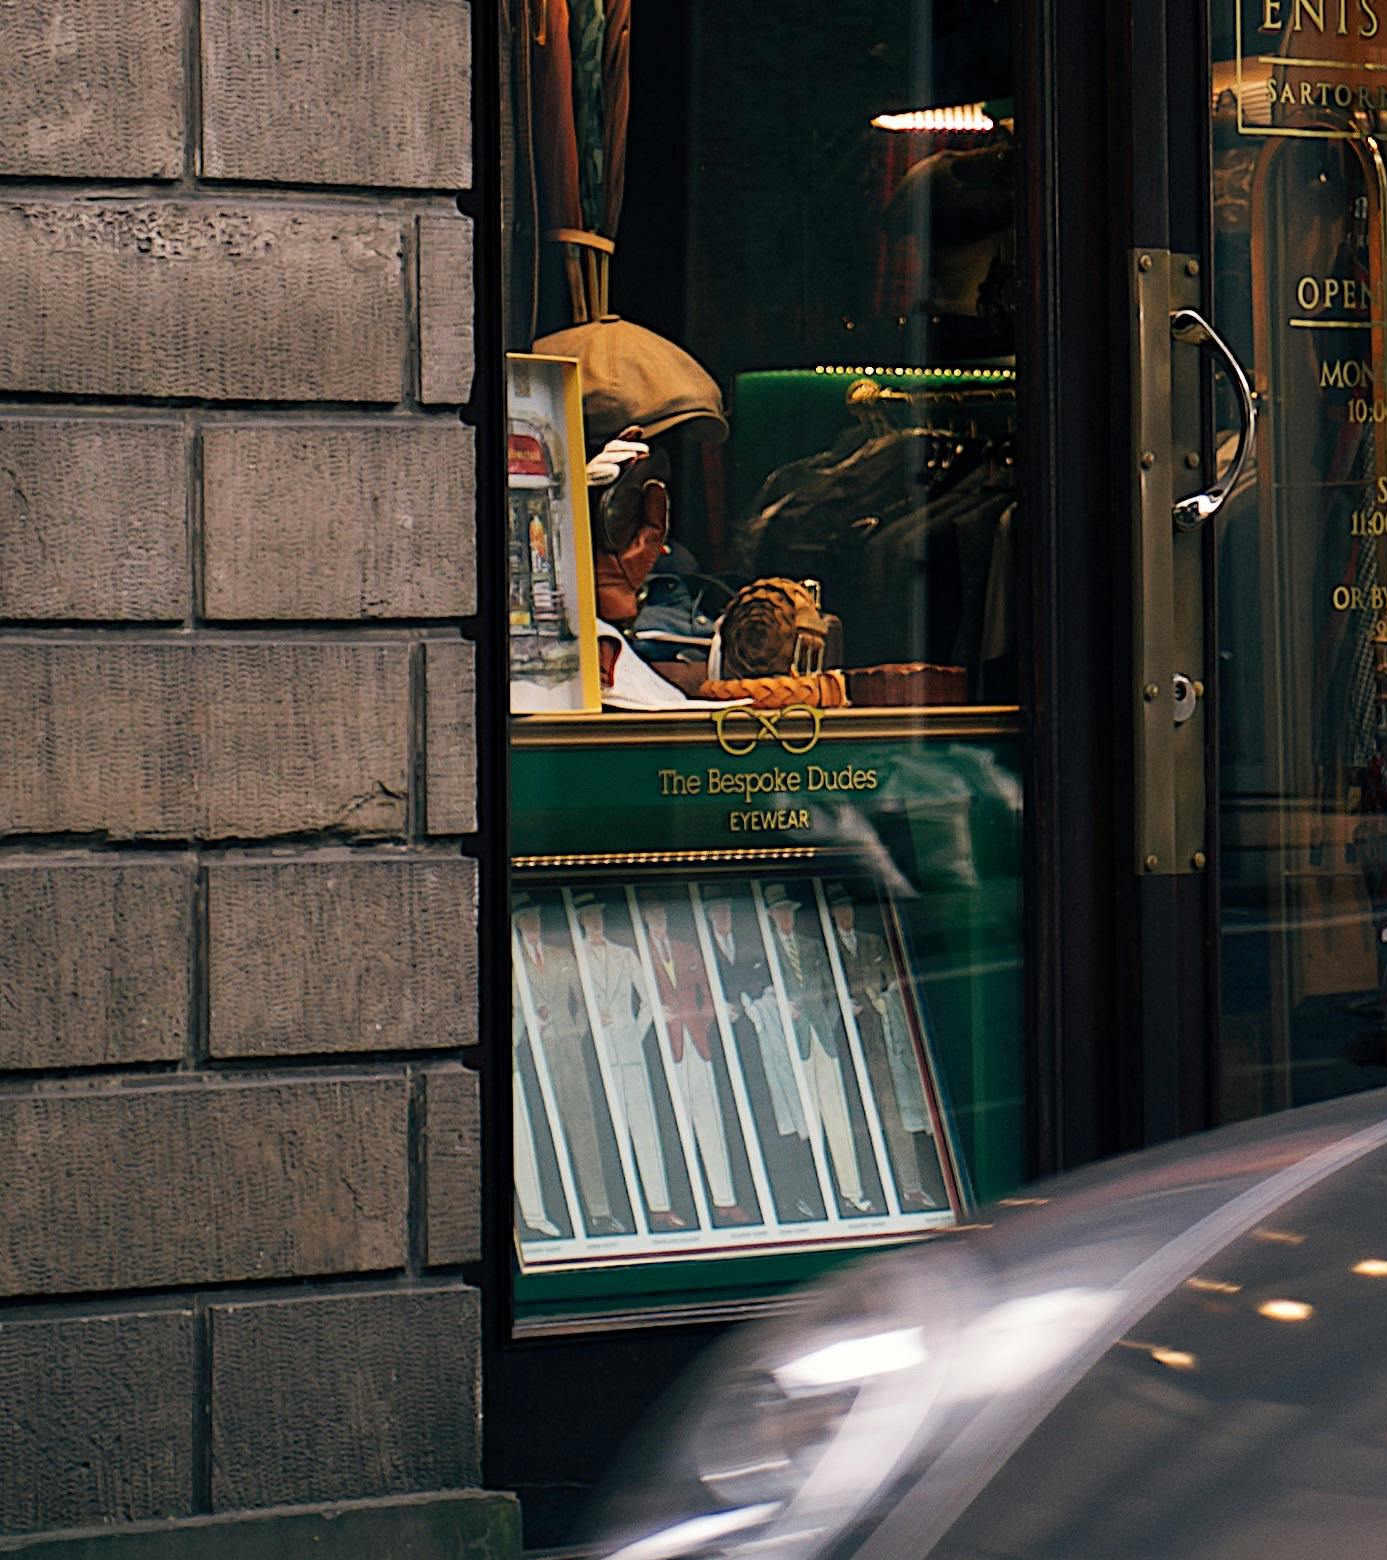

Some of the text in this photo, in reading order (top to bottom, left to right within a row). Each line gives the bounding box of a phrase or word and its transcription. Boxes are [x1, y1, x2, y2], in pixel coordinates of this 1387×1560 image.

[1332, 586, 1364, 610] OR
[658, 764, 878, 803] The Bespoke Dudes
[729, 809, 809, 832] EYEWEAR
